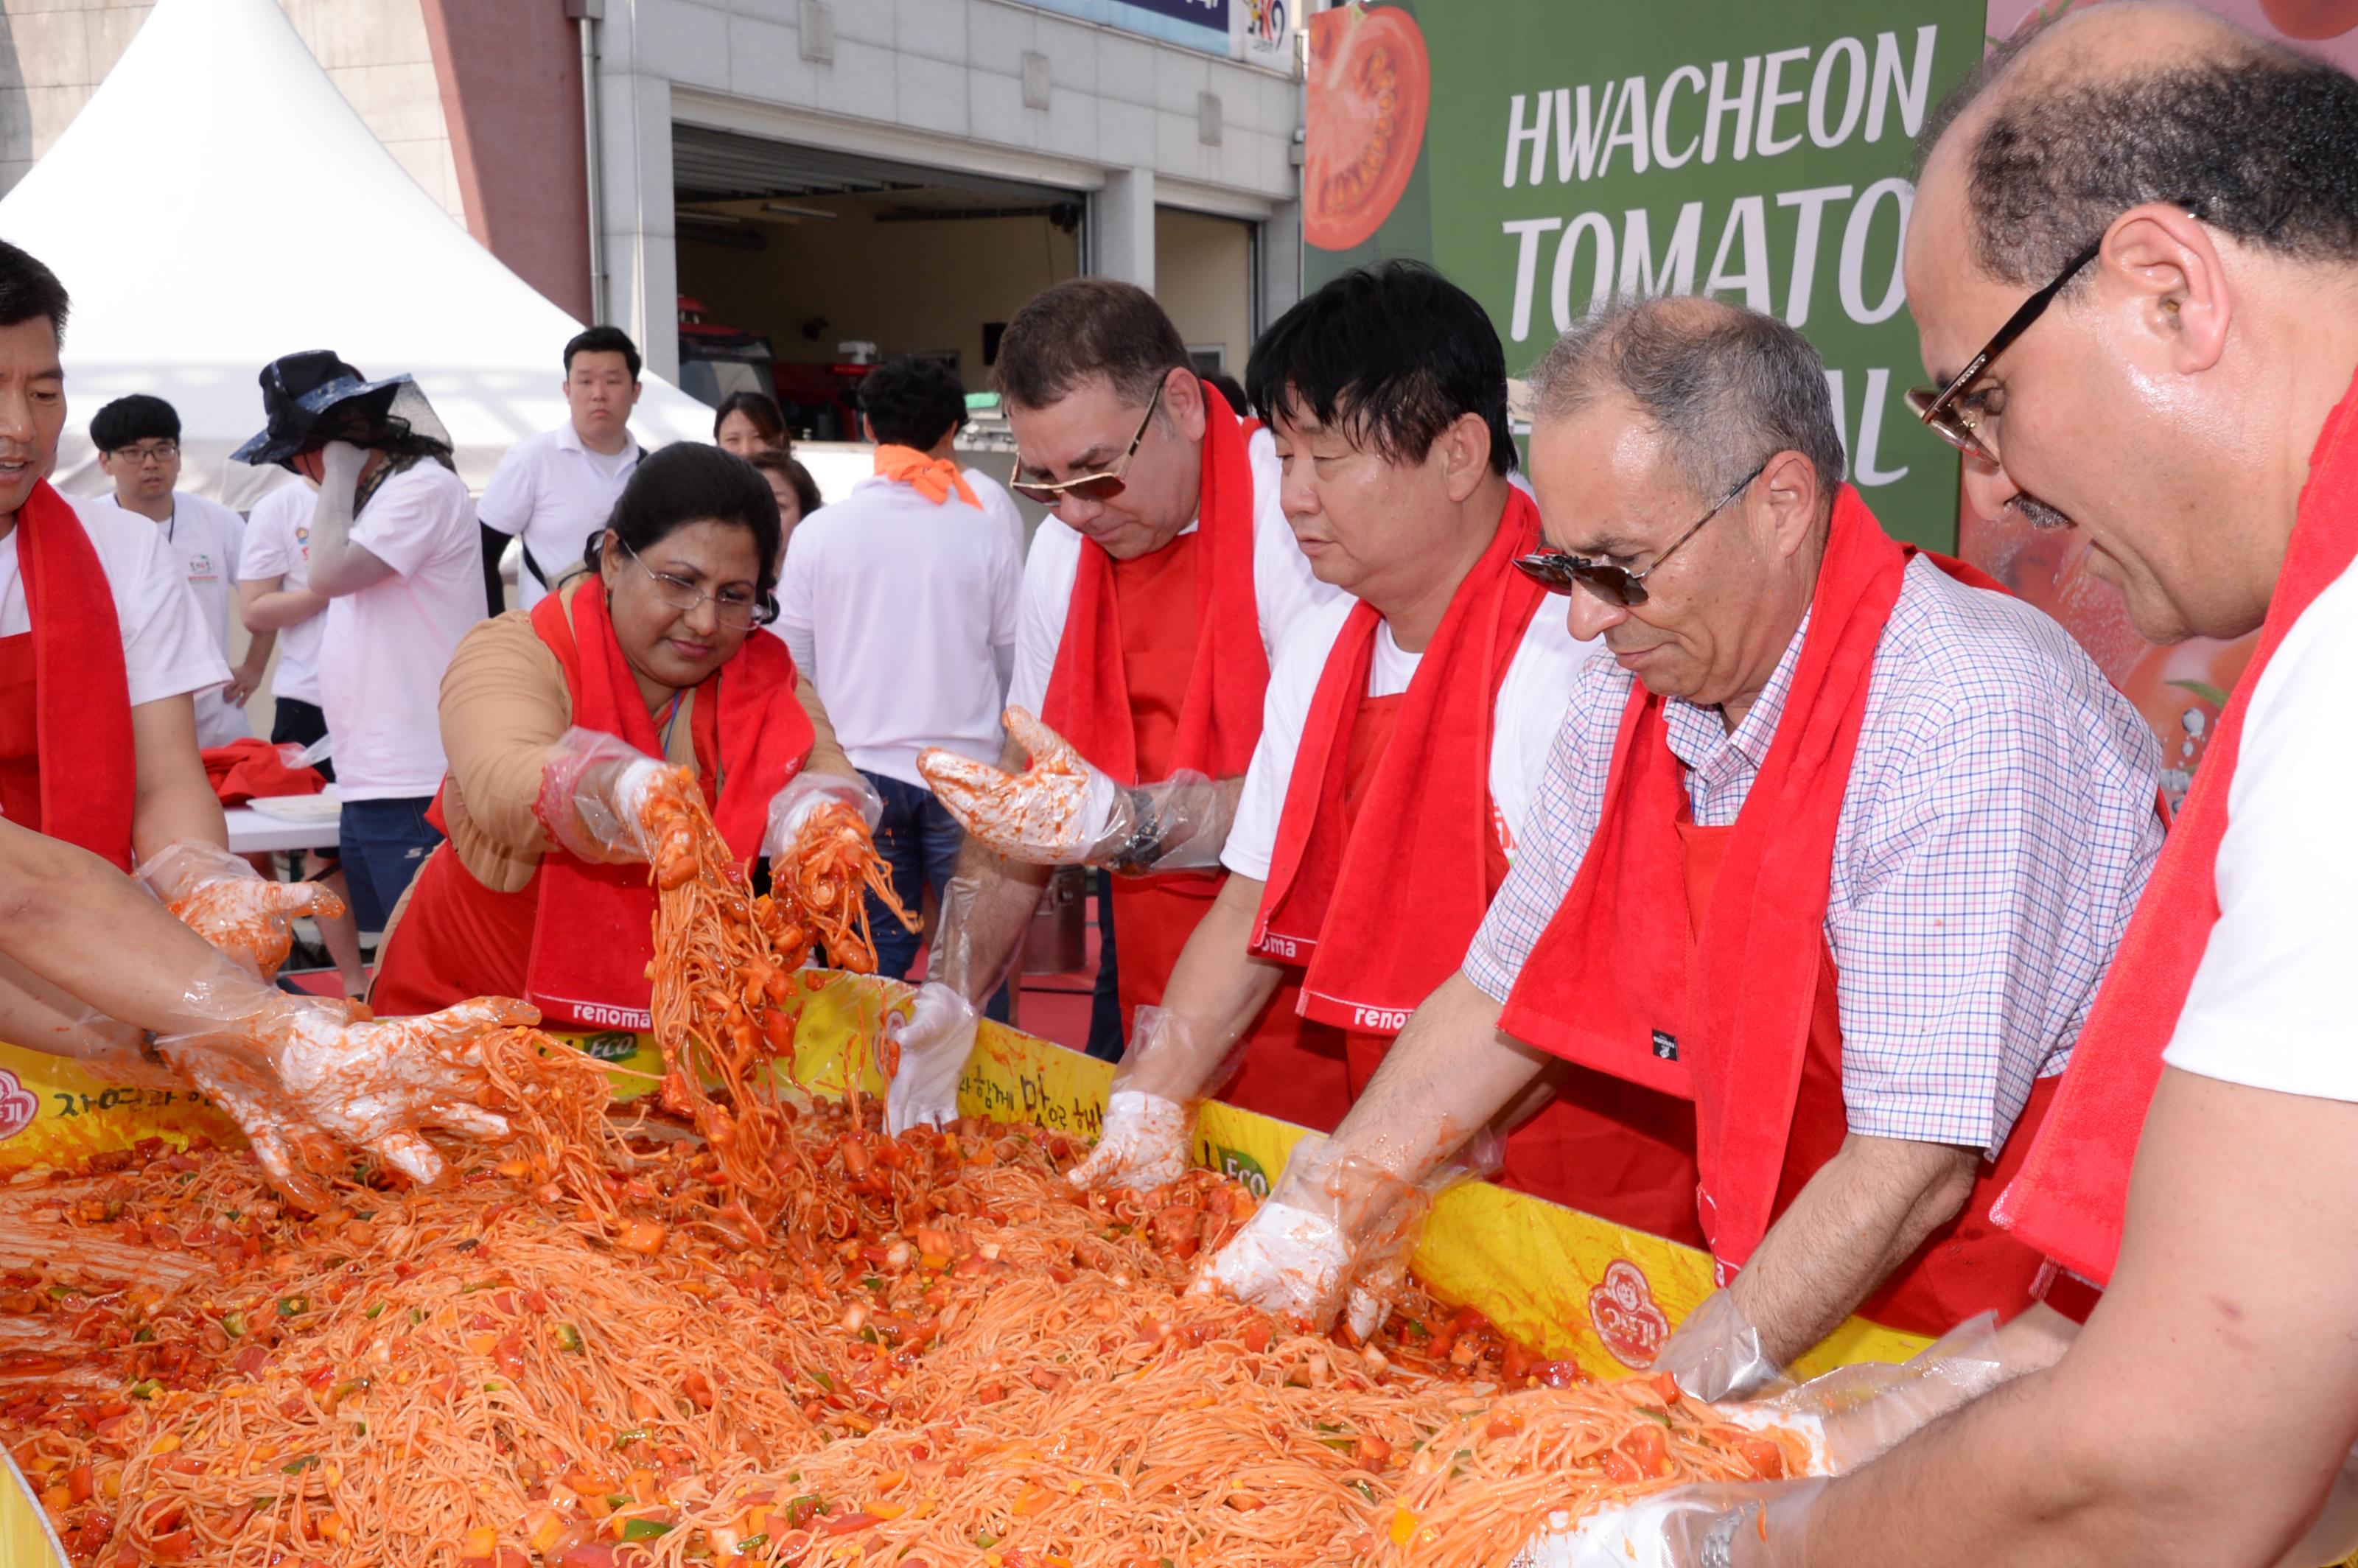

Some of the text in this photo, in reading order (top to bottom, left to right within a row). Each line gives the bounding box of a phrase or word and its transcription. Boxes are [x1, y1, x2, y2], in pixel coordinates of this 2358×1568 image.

[1503, 25, 1937, 188] HWACHEON
[1503, 178, 1914, 342] TOMATO
[573, 1004, 651, 1029] renoma
[1354, 1007, 1410, 1030] reno
[590, 1035, 634, 1059] ECO
[1226, 1157, 1267, 1199] ECO
